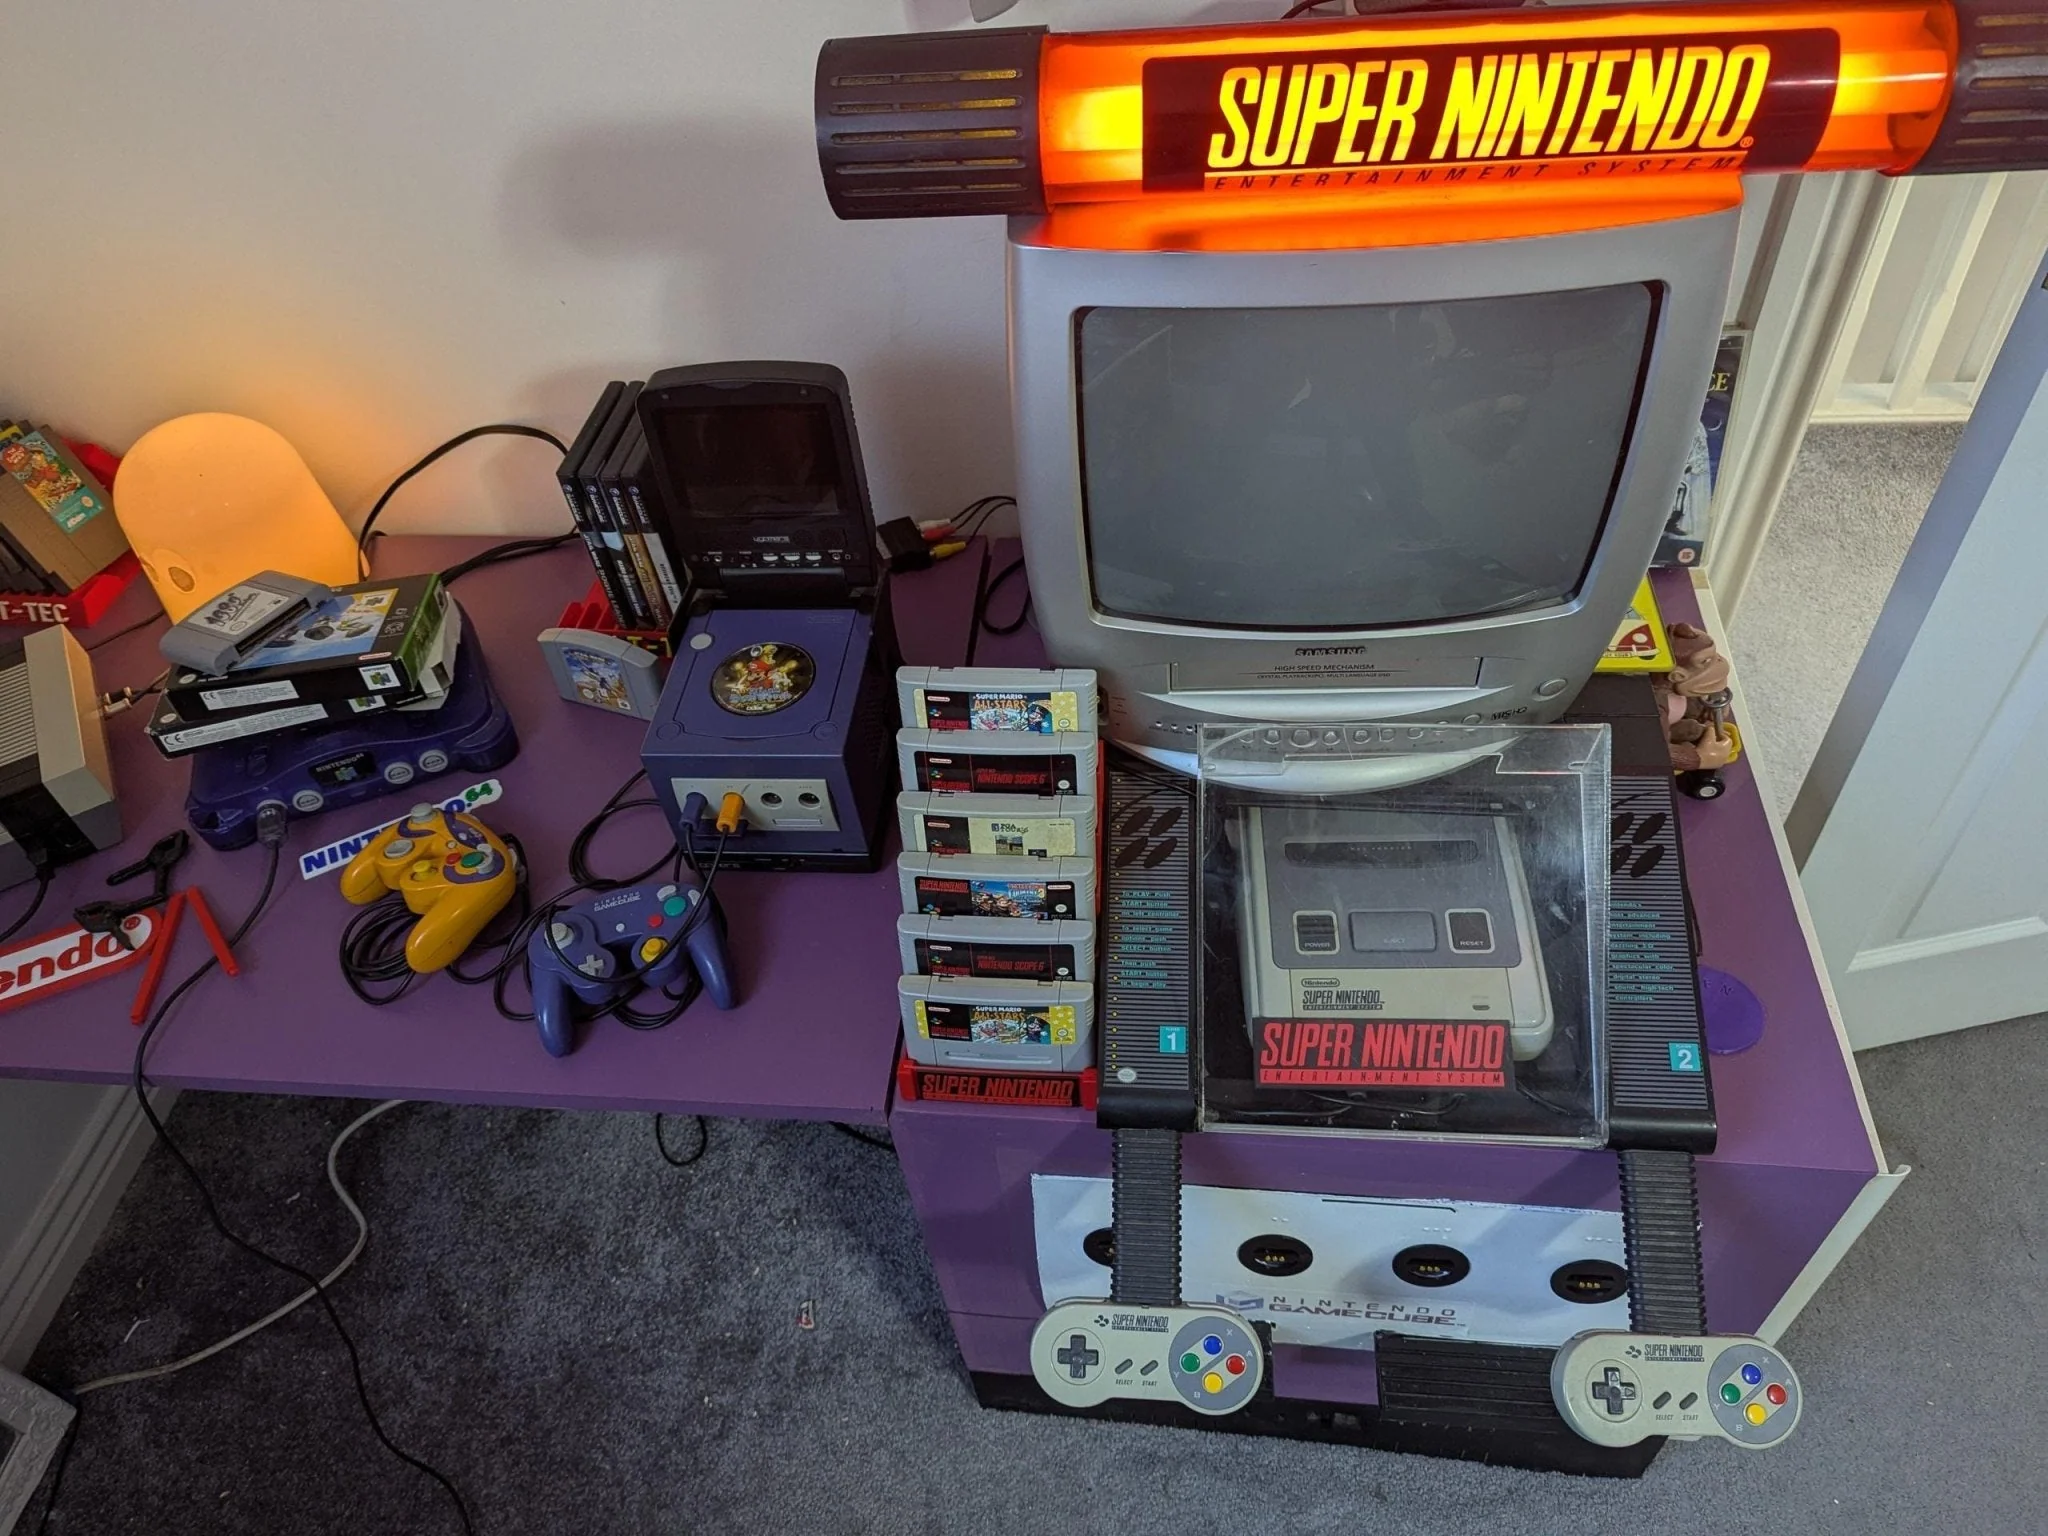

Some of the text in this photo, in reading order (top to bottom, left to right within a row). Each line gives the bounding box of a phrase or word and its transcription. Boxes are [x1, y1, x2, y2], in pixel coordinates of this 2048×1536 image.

[1207, 44, 1771, 168] SUPER NINTENDO
[1214, 157, 1736, 189] ENTERTAINMENT SYSTEM
[1294, 646, 1367, 657] SAMSUNG
[1324, 663, 1375, 671] MECHANISM
[1304, 979, 1338, 988] Nintendo
[1303, 990, 1381, 1004] SUPER NINTENDO
[1167, 1032, 1177, 1051] 1
[1260, 1022, 1505, 1069] SUPER NINTENDO
[1678, 1049, 1694, 1069] 2
[923, 1074, 979, 1095] SUPER
[985, 1077, 1075, 1100] NINTENDO
[1263, 1071, 1501, 1084] ENTERTAINMENT SYSTEM
[1269, 1303, 1457, 1326] GAMECUBE
[1273, 1296, 1456, 1317] NINTENDO
[1111, 1313, 1169, 1328] SUPER NINTENDO
[1644, 1343, 1704, 1357] SUPER NINTENDO
